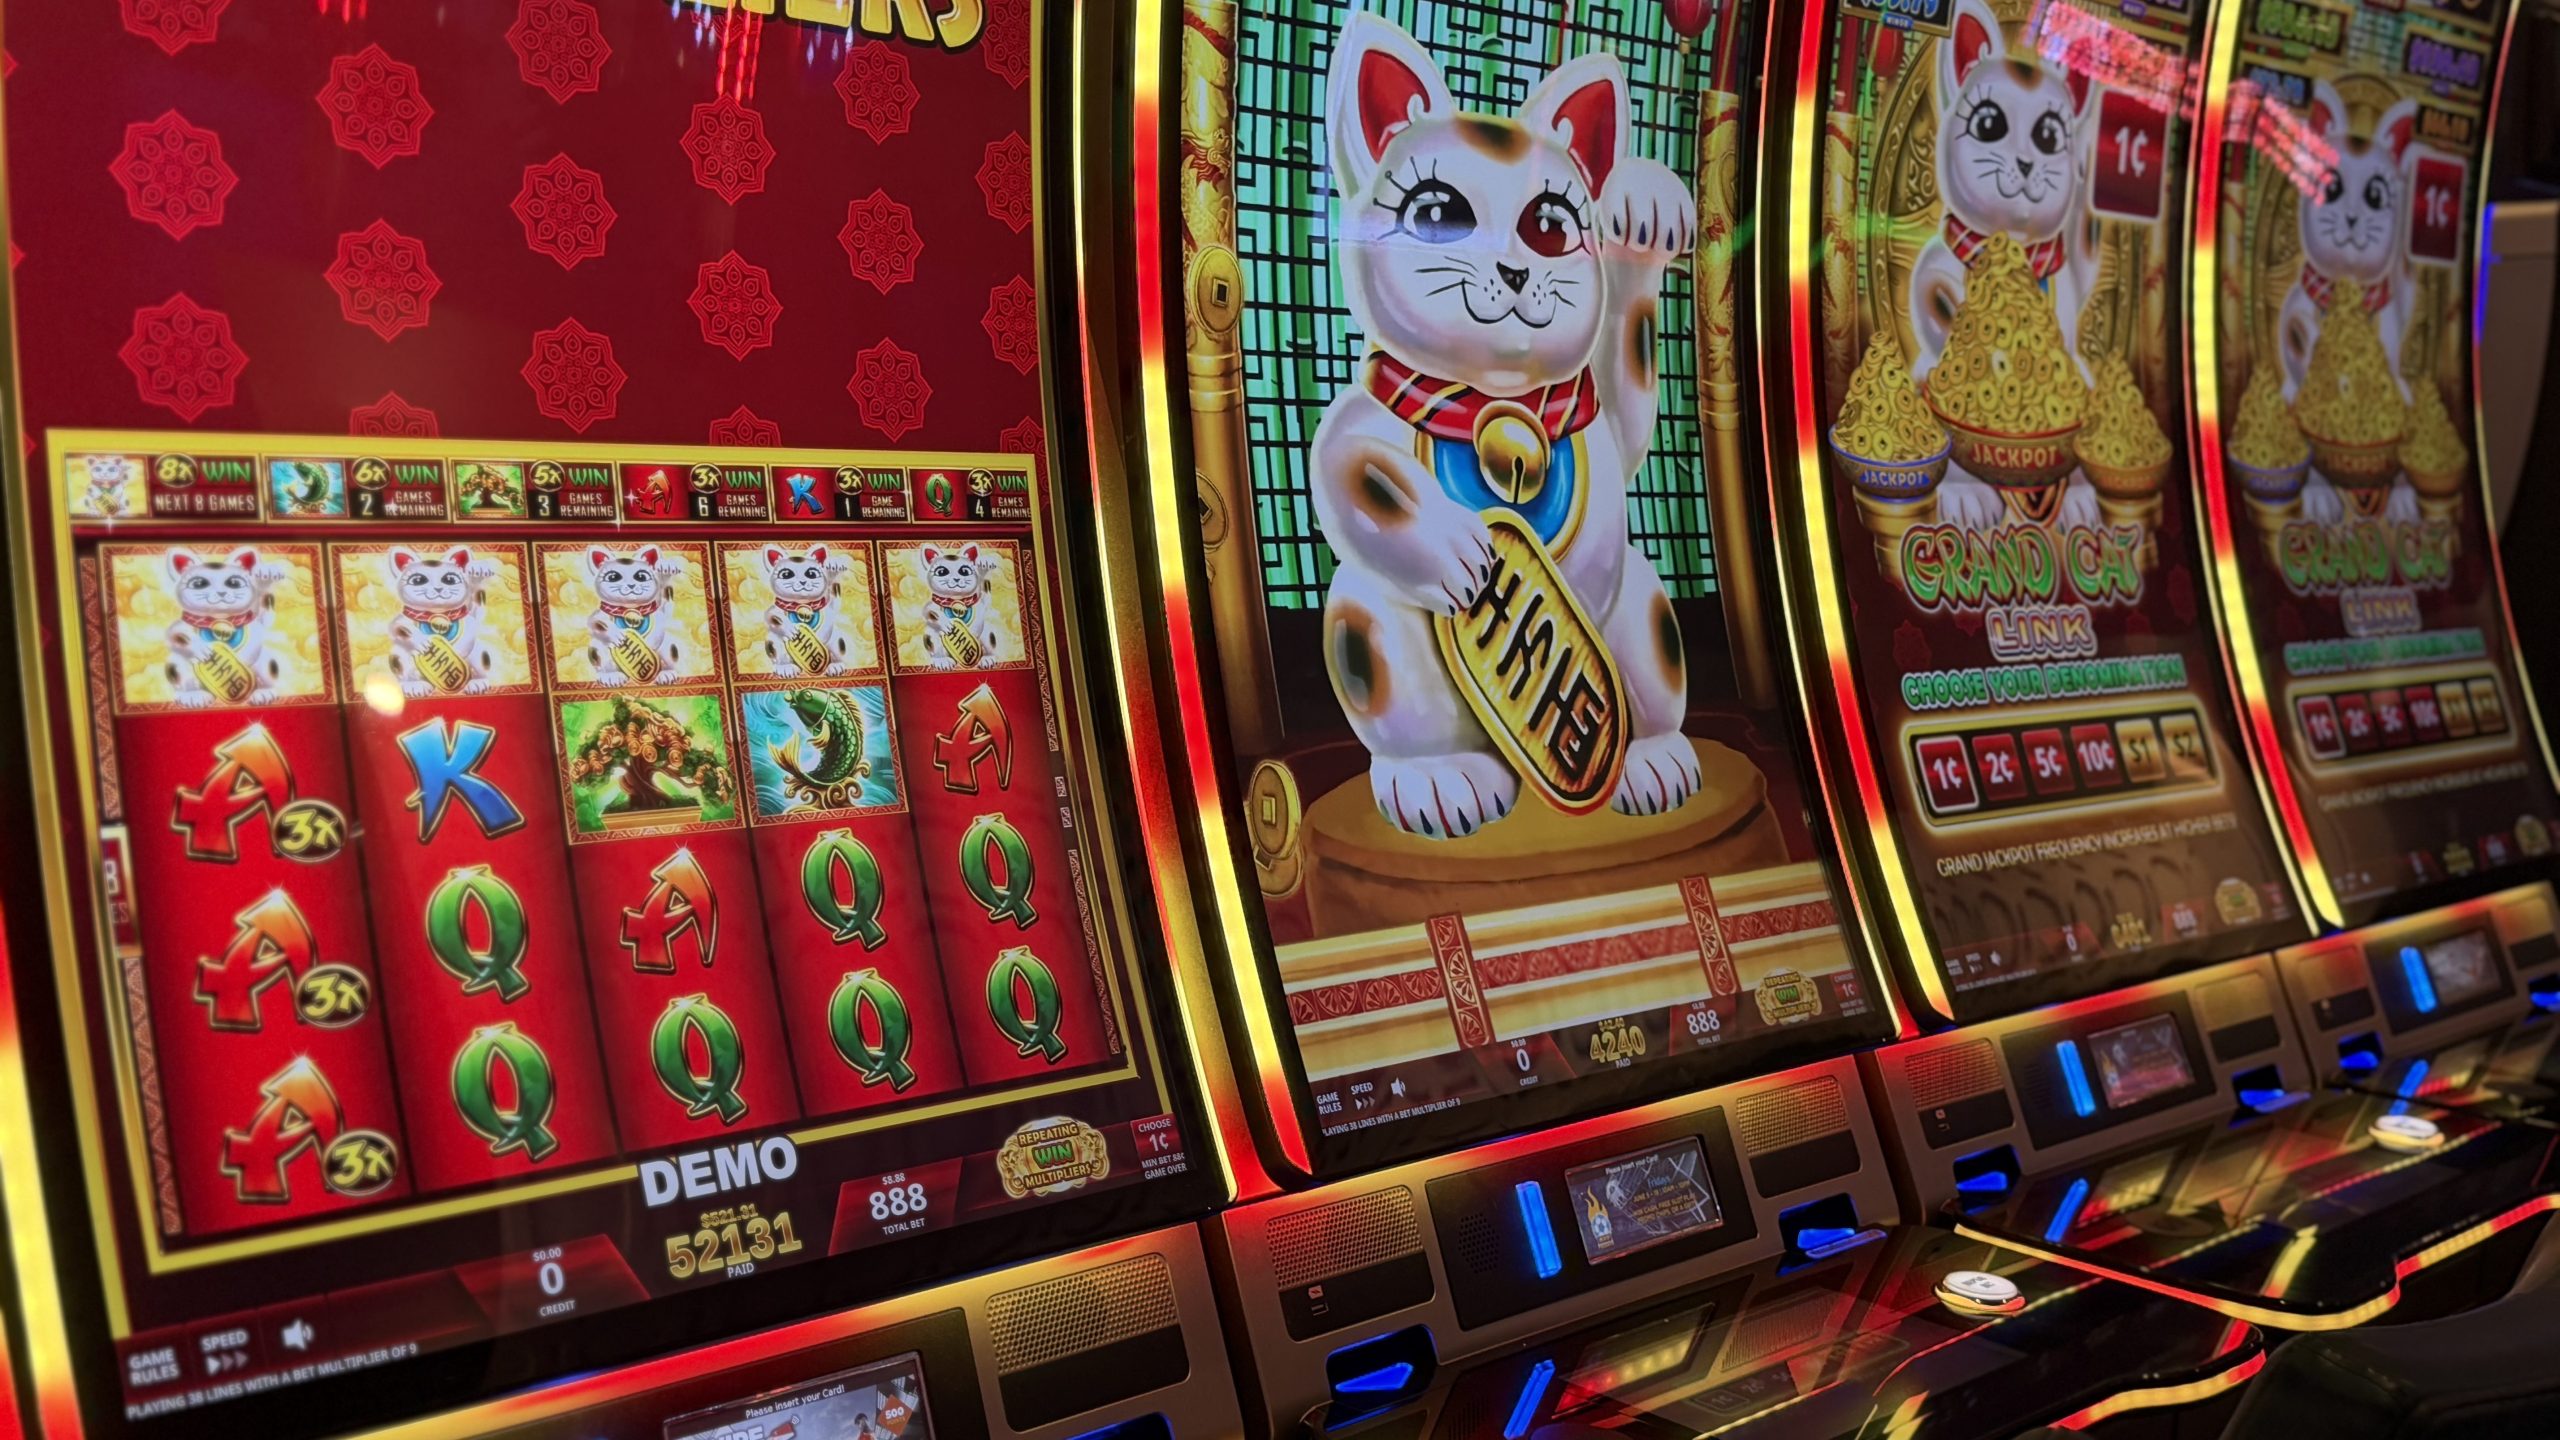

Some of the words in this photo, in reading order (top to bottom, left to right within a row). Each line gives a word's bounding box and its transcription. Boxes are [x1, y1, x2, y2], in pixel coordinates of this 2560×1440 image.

[2115, 126, 2149, 178] 1¢
[1973, 443, 2058, 468] JACKPOT
[202, 461, 251, 482] WIN
[395, 464, 440, 485] WIN
[568, 467, 609, 487] WIN
[725, 470, 763, 489] WIN
[867, 473, 901, 491] WIN
[997, 475, 1029, 492] WIN
[1863, 470, 1926, 487] JACKPOT
[155, 494, 189, 512] NEXT
[195, 494, 205, 511] 8
[209, 493, 256, 511] GAMES
[395, 491, 432, 504] GAMES
[569, 492, 603, 505] GAMES
[635, 470, 674, 515] A
[726, 494, 757, 506] GAMES
[786, 473, 825, 515] K
[871, 495, 894, 507] GAME
[924, 472, 954, 518] Q
[998, 496, 1024, 507] GAMES
[361, 493, 373, 517] 2
[385, 502, 445, 517] REMAINING
[539, 494, 551, 517] 3
[560, 505, 614, 518] REMAINING
[698, 496, 709, 517] 6
[718, 505, 768, 518] REMAINING
[862, 506, 906, 519] REMAINING
[975, 498, 985, 518] 4
[1902, 524, 2059, 612] GRAND
[2066, 524, 2143, 605] CAT
[1988, 606, 2096, 658] LINK
[1902, 671, 1989, 710] CHOOSE
[1985, 664, 2048, 703] YOUR
[2043, 653, 2188, 699] DENOMINATION
[933, 684, 1014, 794] A
[2128, 737, 2150, 763] $1
[2174, 731, 2197, 758] $2
[1985, 751, 2014, 784] 2¢
[2035, 745, 2063, 779] 5¢
[2078, 740, 2116, 773] 10¢
[396, 717, 528, 843] K
[1933, 757, 1962, 790] 1¢
[170, 720, 296, 861] A
[1936, 853, 1983, 878] GRAND
[1984, 843, 2036, 871] JACKPOT
[2034, 833, 2102, 861] FREQUENCY
[957, 812, 1039, 929] Q
[800, 827, 889, 950] Q
[618, 846, 720, 975] A
[424, 865, 532, 1001] Q
[193, 887, 318, 1033] A
[985, 944, 1070, 1063] Q
[826, 967, 917, 1092] Q
[1686, 1009, 1720, 1035] 888
[1589, 1025, 1646, 1063] 4240
[650, 992, 748, 1126] Q
[1516, 1048, 1531, 1072] 0
[1615, 1058, 1631, 1069] PAID
[450, 1022, 562, 1163] Q
[1316, 1091, 1339, 1105] GAME
[1350, 1081, 1374, 1095] SPEED
[1318, 1102, 1342, 1115] RULES
[1357, 1117, 1376, 1129] LINES
[1376, 1112, 1394, 1125] WITH
[1400, 1108, 1411, 1119] BET
[1411, 1101, 1447, 1118] MULTIPLIER
[219, 1053, 346, 1204] A
[1018, 1123, 1079, 1144] REPEATING
[1138, 1119, 1172, 1133] CHOOSE
[1033, 1142, 1073, 1166] WIN
[1149, 1132, 1169, 1152] 1¢
[639, 1136, 798, 1207] DEMO
[1142, 1158, 1158, 1169] MIN
[1158, 1155, 1172, 1166] BET
[1144, 1168, 1166, 1180] GAME
[1167, 1164, 1187, 1176] OVER
[882, 1172, 906, 1185] $8.88
[1024, 1163, 1091, 1188] MULTIPLIERS
[869, 1183, 928, 1220] 888
[700, 1203, 759, 1229] $521.31
[882, 1222, 909, 1236] TOTAL
[910, 1217, 926, 1229] BET
[532, 1247, 562, 1262] $0.00
[666, 1211, 803, 1279] 52131
[540, 1262, 565, 1295] 0
[727, 1262, 755, 1279] PAID
[539, 1299, 576, 1318] CREDIT
[202, 1331, 248, 1352] SPEED
[129, 1347, 175, 1370] GAME
[125, 1394, 187, 1420] PLAYING
[206, 1382, 243, 1402] LINES
[244, 1374, 279, 1393] WITH
[281, 1371, 292, 1384] A
[292, 1366, 315, 1382] BET
[317, 1350, 389, 1376] MULTIPLIER
[391, 1345, 407, 1359] OF
[409, 1343, 418, 1355] 9
[130, 1363, 180, 1387] RULES
[745, 1405, 773, 1420] Please
[774, 1397, 800, 1411] insert
[801, 1391, 821, 1406] your
[822, 1383, 845, 1398] Card!
[885, 1406, 905, 1420] 500
